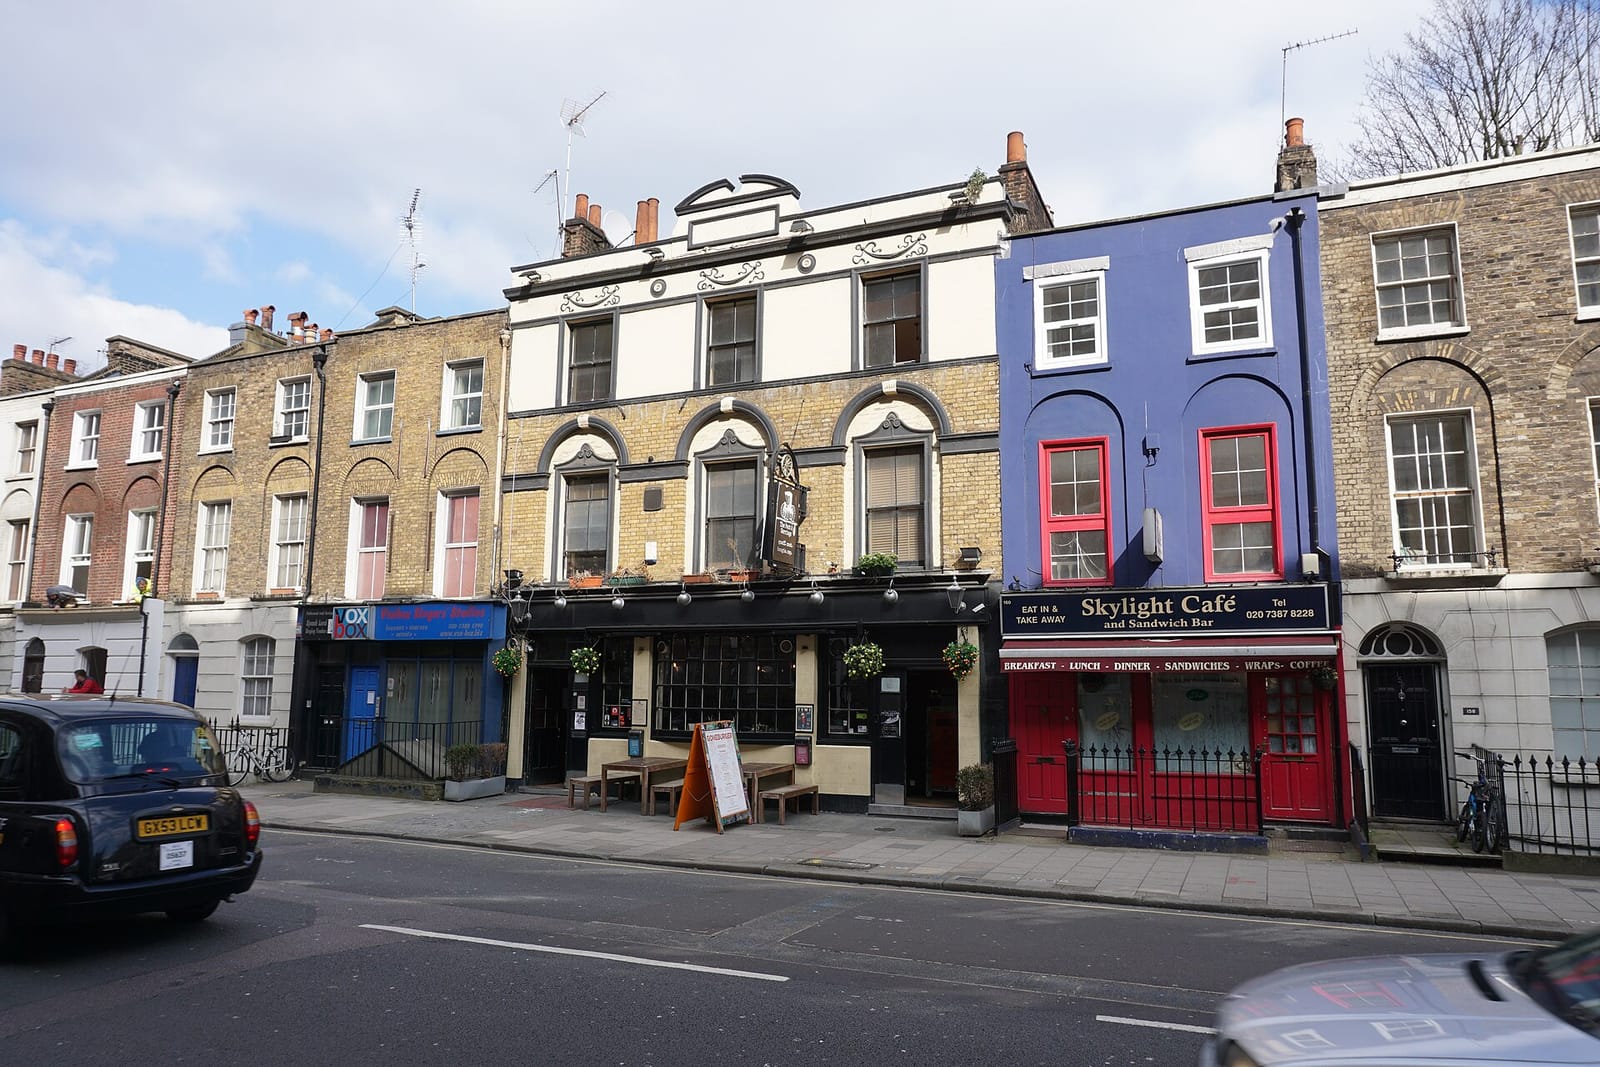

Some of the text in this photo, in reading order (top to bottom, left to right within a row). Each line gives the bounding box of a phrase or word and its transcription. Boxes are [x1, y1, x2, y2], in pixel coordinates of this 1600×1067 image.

[1081, 594, 1236, 620] Skylight Café
[1272, 599, 1286, 607] Tel
[1021, 605, 1058, 614] EAT IN &
[1246, 609, 1314, 619] 020 7387 8228
[1016, 615, 1066, 624] TAKE AWAY
[1104, 618, 1214, 629] and Sandwich Bar
[1004, 662, 1056, 670] BREAKFAST
[1069, 662, 1100, 670] LUNCH
[1114, 662, 1151, 670] DINNER
[1164, 662, 1230, 670] SANDWICHES
[144, 818, 202, 834] GX53 LCW
